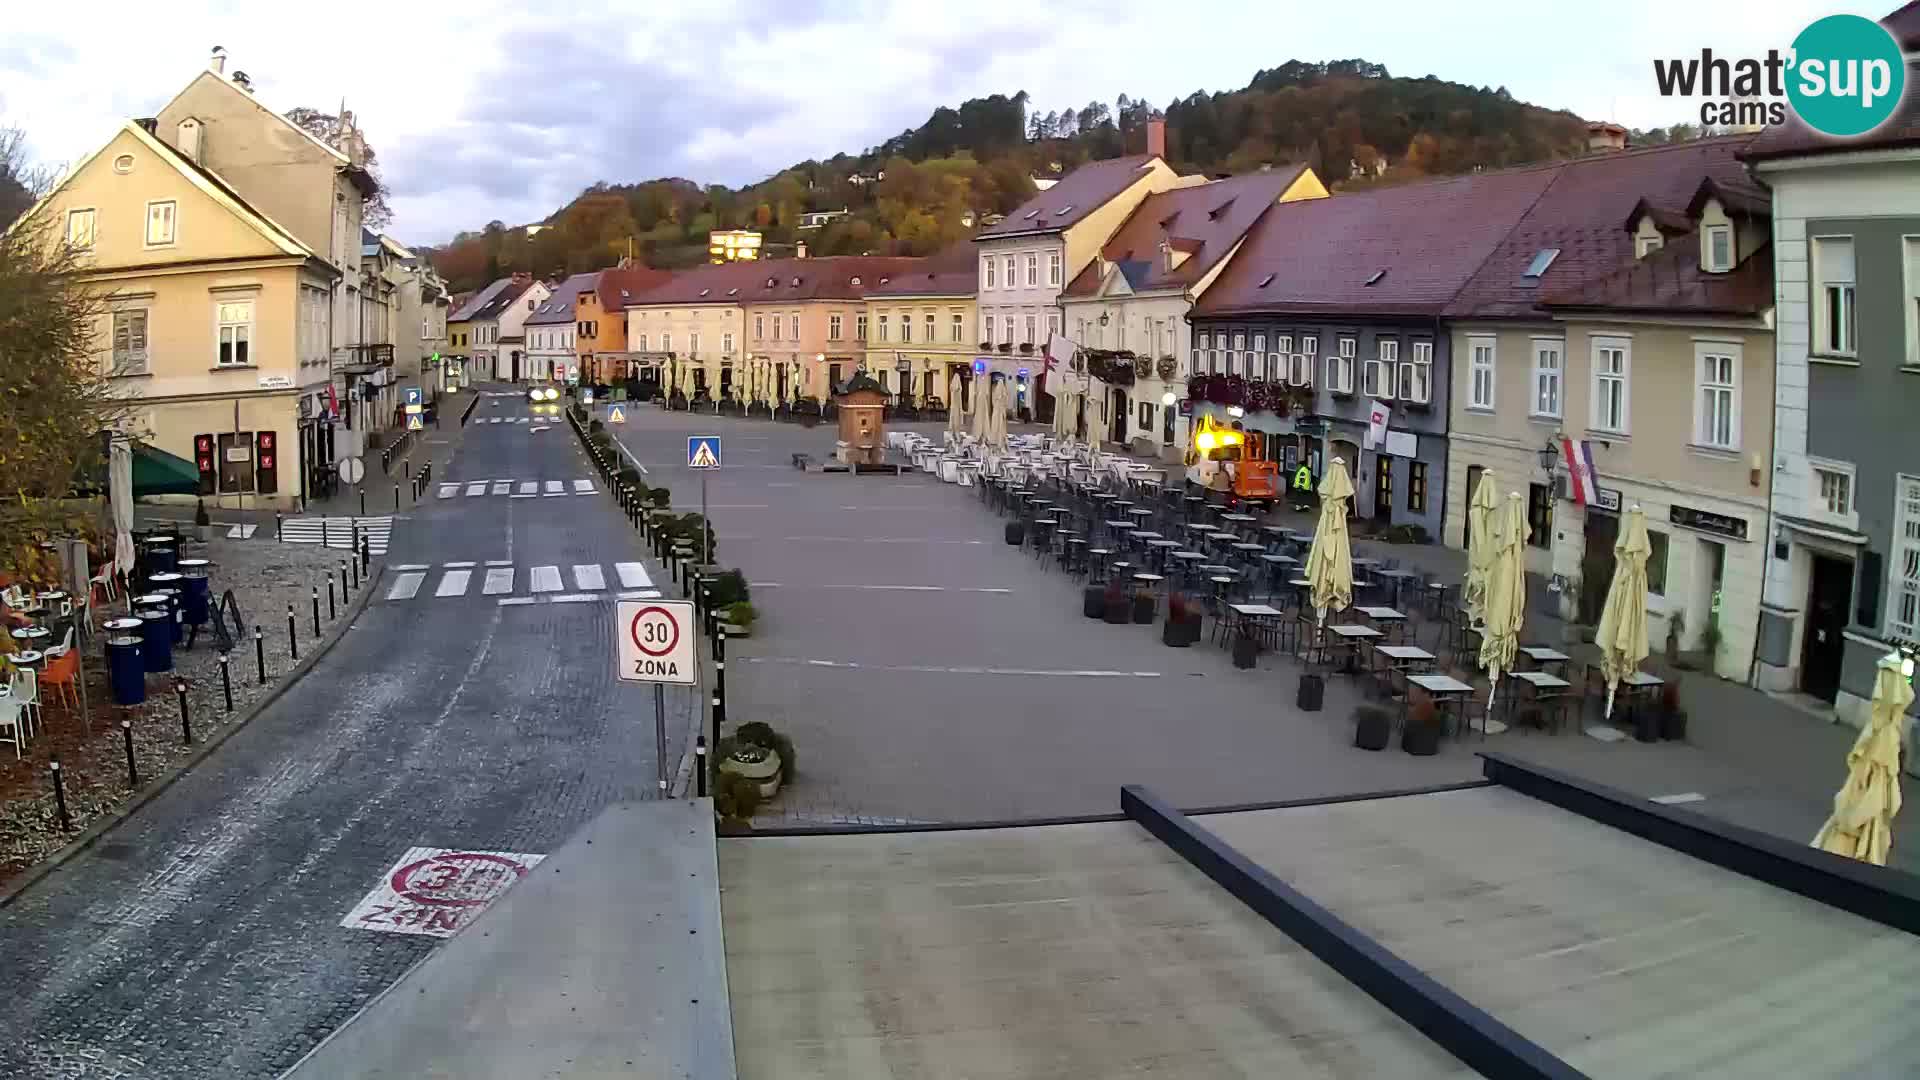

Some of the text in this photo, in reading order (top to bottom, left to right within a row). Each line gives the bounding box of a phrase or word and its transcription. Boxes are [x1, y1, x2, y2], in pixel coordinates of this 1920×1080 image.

[644, 622, 668, 643] 30
[634, 659, 678, 676] ZONA
[359, 903, 462, 932] ZON
